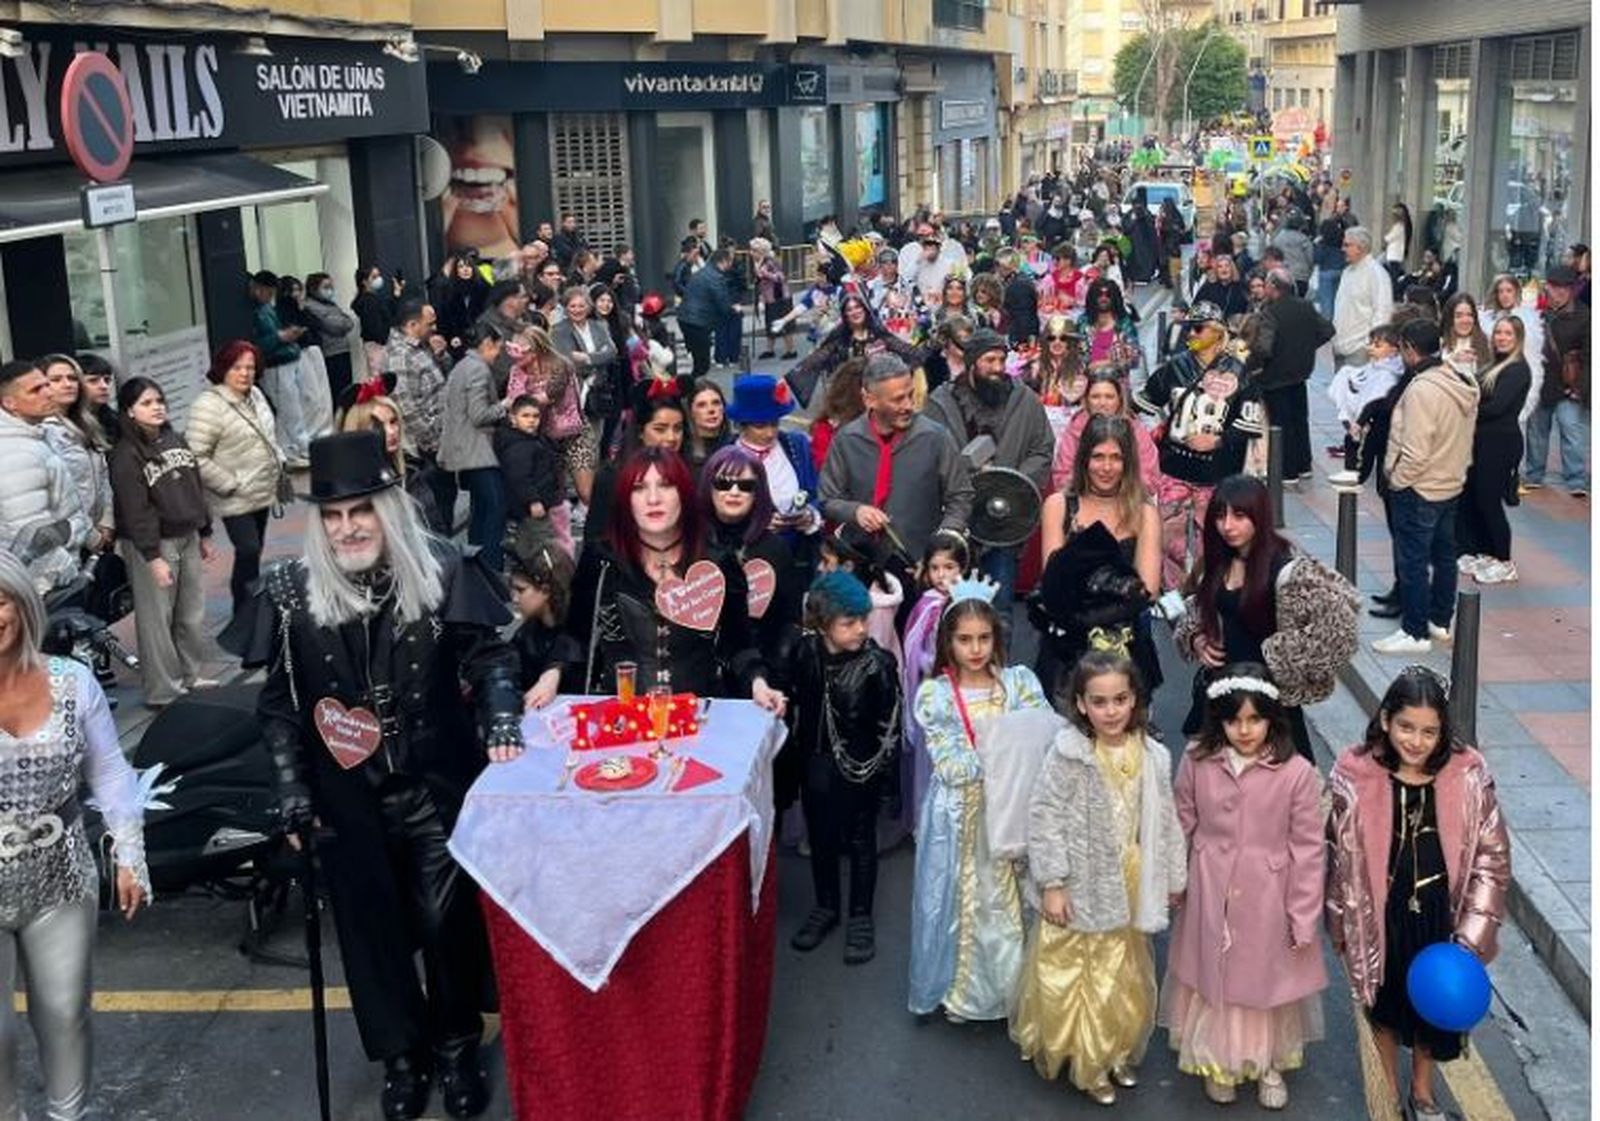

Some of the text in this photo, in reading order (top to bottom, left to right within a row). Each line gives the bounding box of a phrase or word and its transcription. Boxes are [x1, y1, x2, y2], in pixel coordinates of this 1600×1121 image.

[257, 57, 385, 91] SALÓN DE UÑAS
[74, 42, 224, 142] AILS
[278, 92, 373, 119] VIETNAMITA
